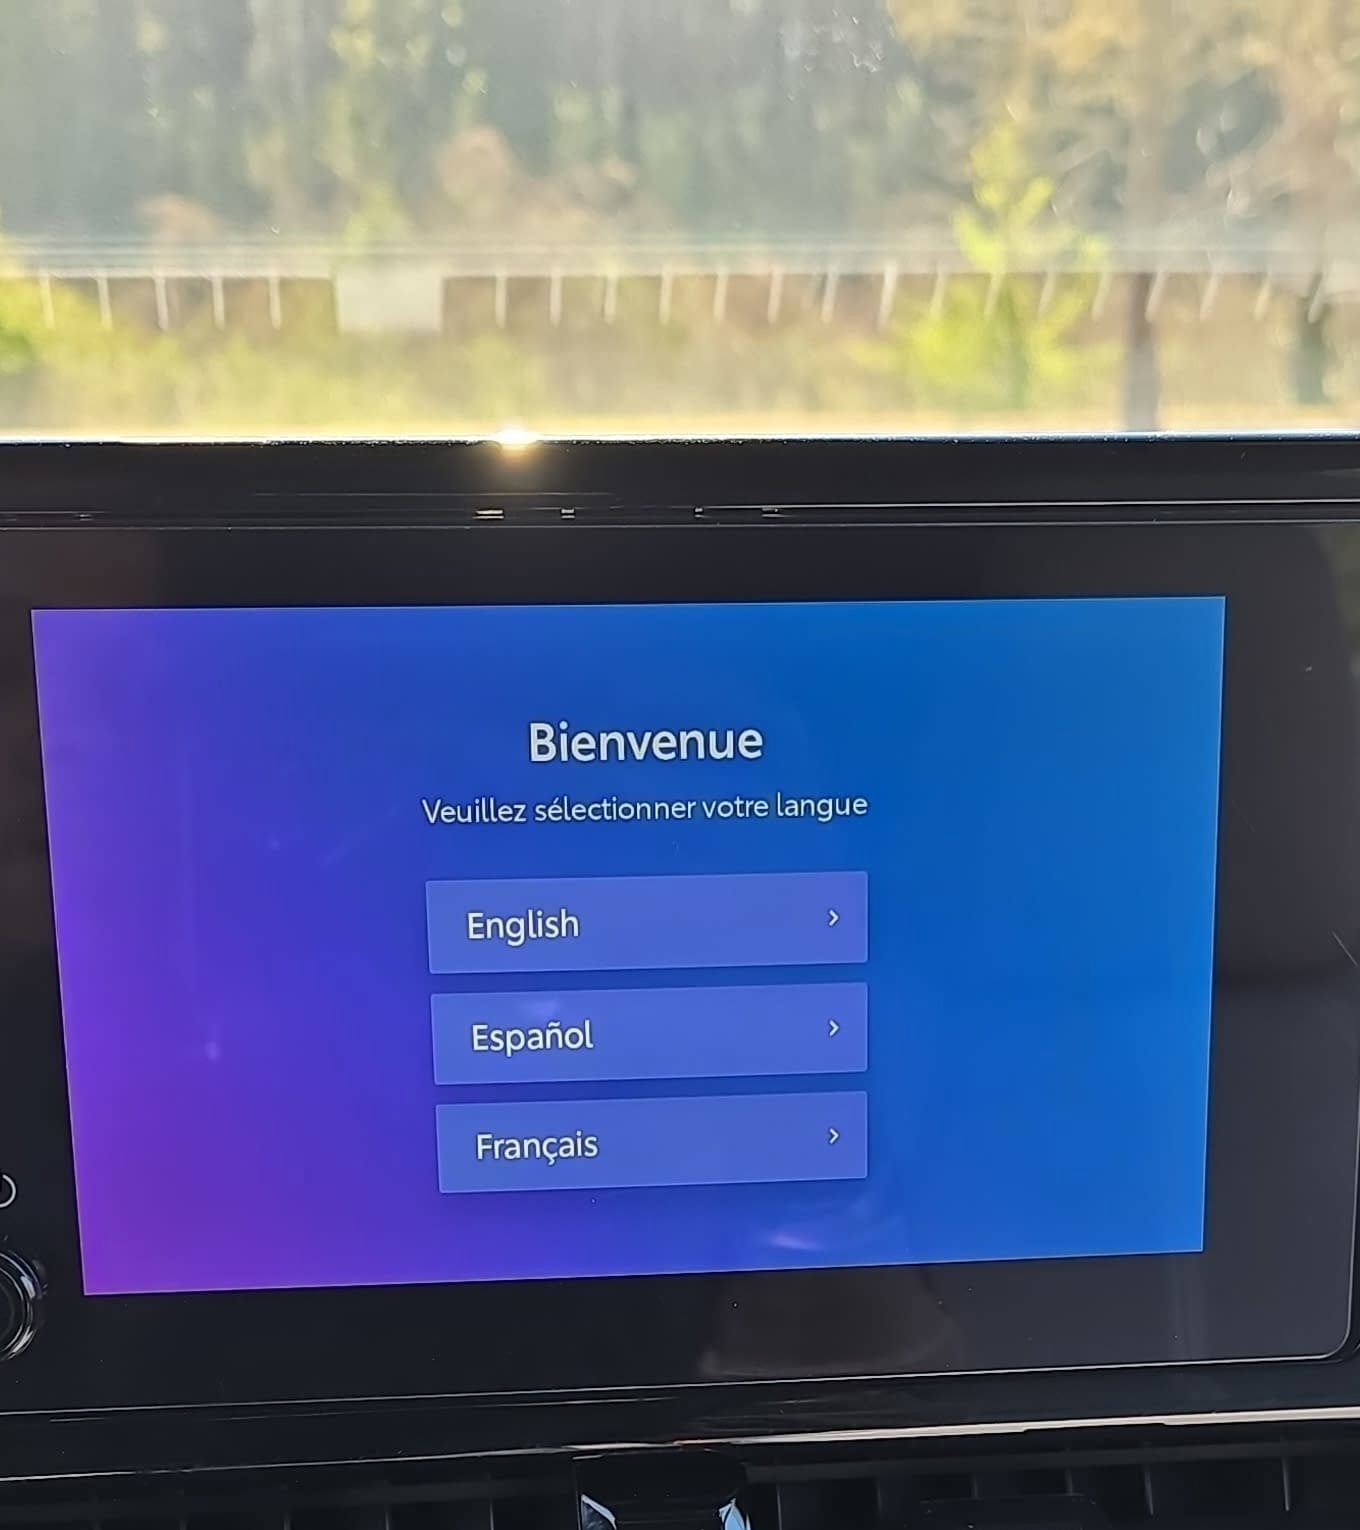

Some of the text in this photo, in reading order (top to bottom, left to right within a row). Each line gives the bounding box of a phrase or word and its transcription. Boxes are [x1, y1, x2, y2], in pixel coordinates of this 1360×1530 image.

[528, 721, 764, 763] Bienvenue
[422, 793, 869, 823] Veuillez sélectionner votre langue
[466, 909, 580, 946] English
[471, 1019, 594, 1056] Español
[475, 1131, 599, 1165] Français
